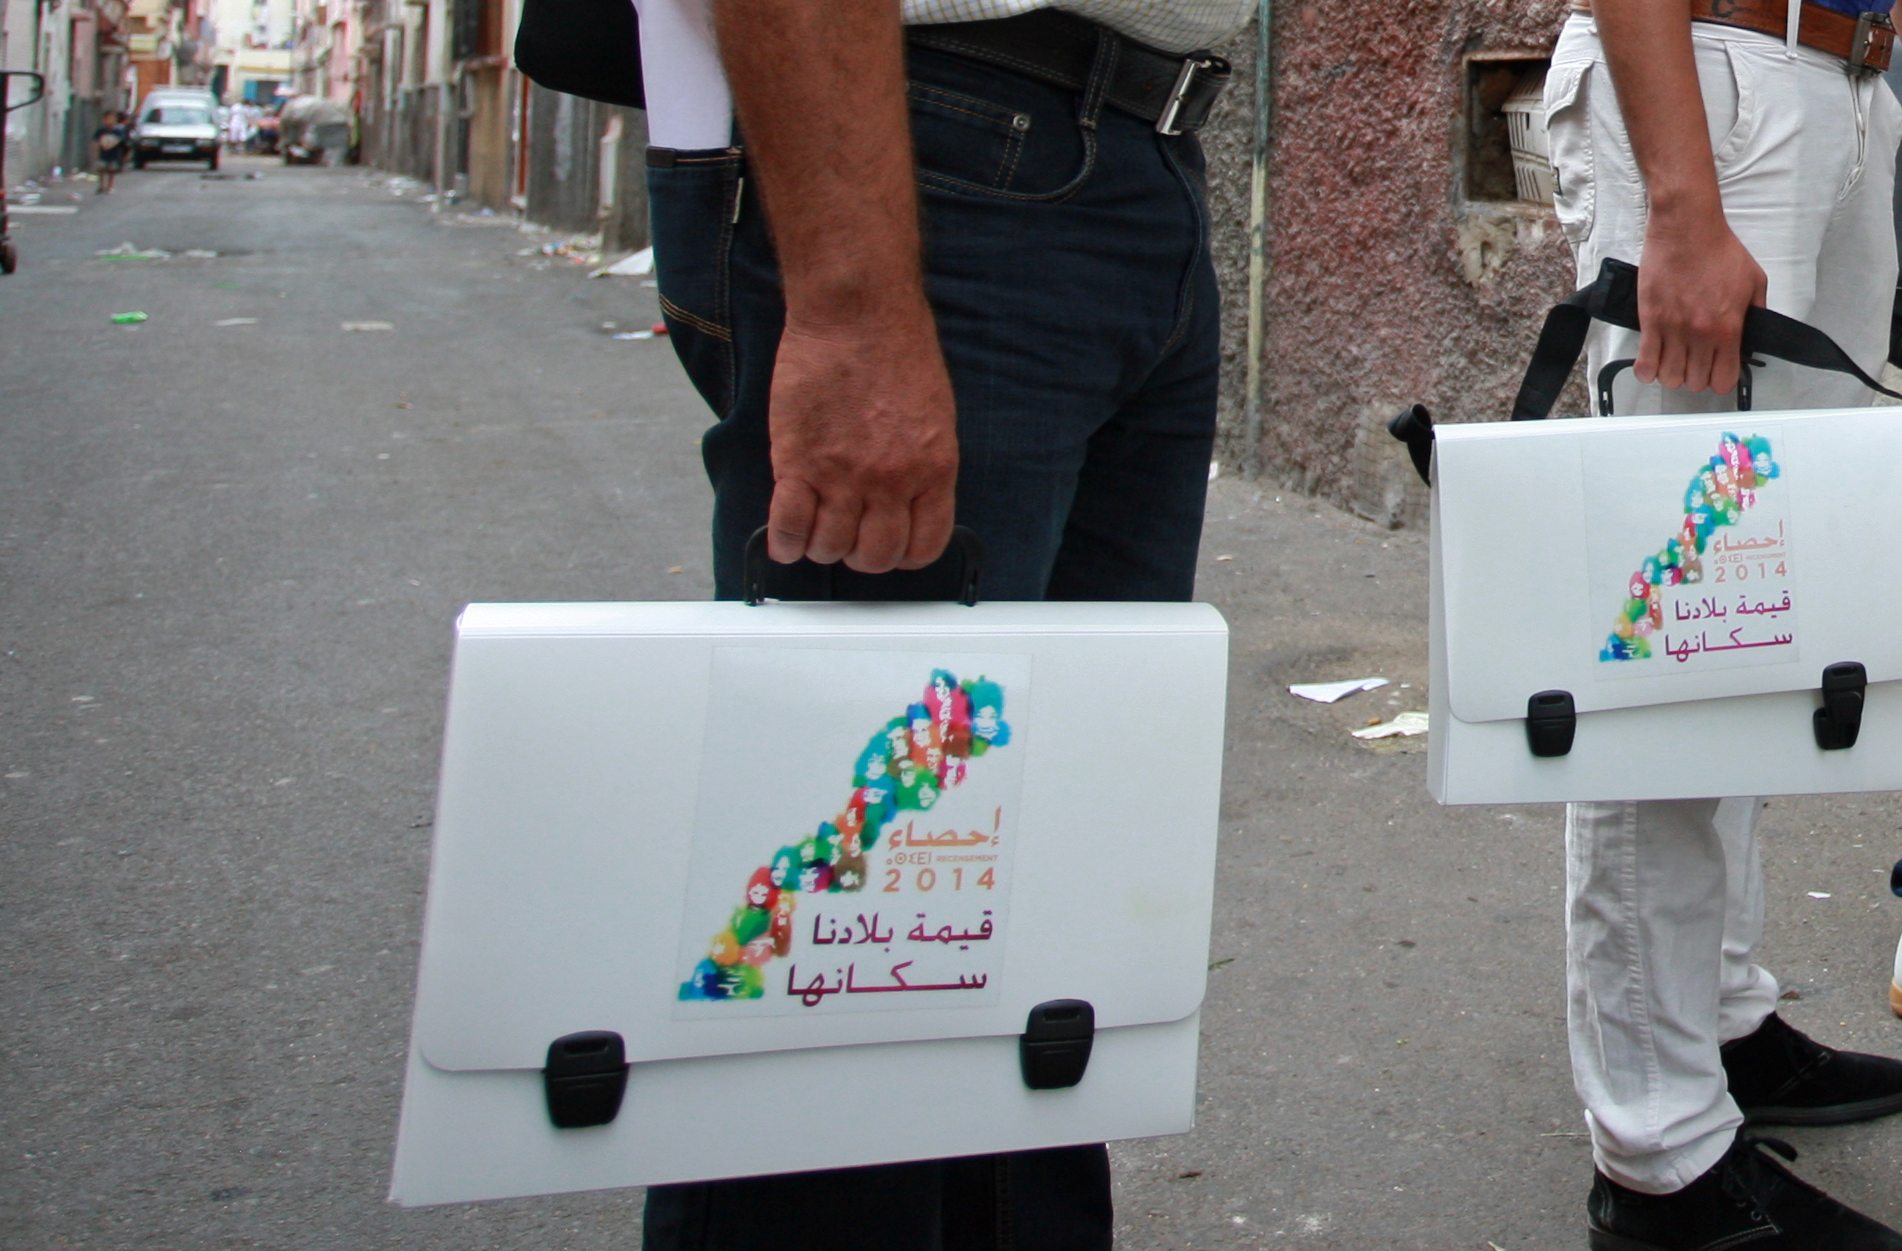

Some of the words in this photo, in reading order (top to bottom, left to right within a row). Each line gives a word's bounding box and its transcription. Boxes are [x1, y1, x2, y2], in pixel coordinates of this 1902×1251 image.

[1713, 519, 1785, 555] إحصاء
[1714, 560, 1787, 584] 2014
[1675, 597, 1728, 623] بلادنا
[1736, 590, 1791, 619] قيمة
[1665, 627, 1793, 662] سكانها
[888, 805, 1002, 851] إحصاء
[883, 866, 995, 893] 2014
[812, 912, 894, 953] بلادنا
[906, 909, 994, 951] قيمة
[787, 960, 988, 1007] سكانها
